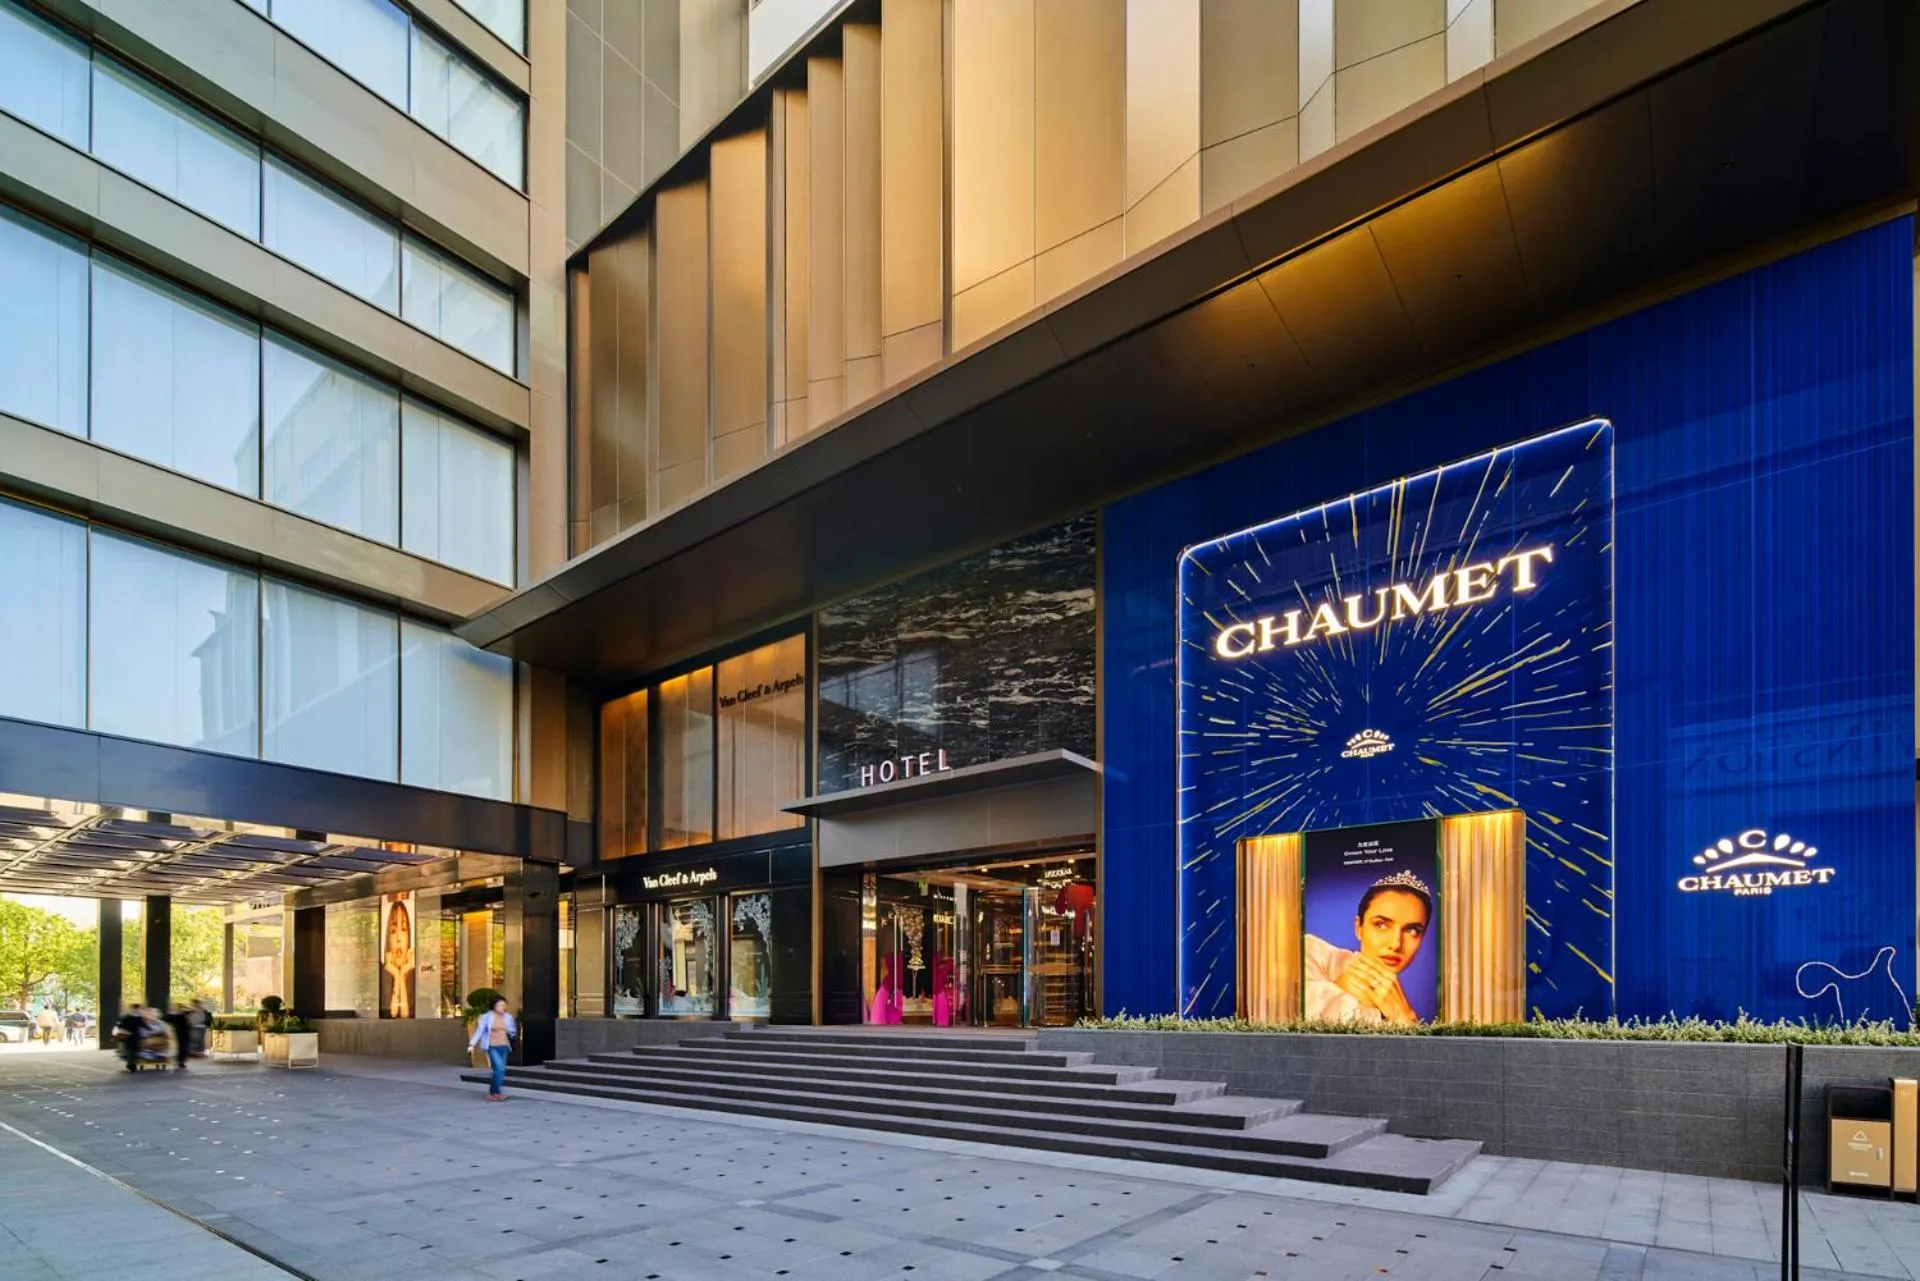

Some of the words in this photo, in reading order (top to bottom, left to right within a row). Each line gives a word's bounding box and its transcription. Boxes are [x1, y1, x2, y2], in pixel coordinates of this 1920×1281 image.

[1215, 544, 1555, 659] CHAUMET
[719, 695, 736, 708] Van
[737, 683, 763, 703] Cleef
[1341, 743, 1395, 758] CHAUMET
[861, 748, 951, 787] HOTEL
[1738, 829, 1767, 849] C
[642, 876, 659, 889] Van
[659, 872, 682, 887] Cleef
[682, 873, 689, 884] &
[689, 867, 718, 886] Arpels
[1677, 867, 1836, 892] CHAUMET
[1733, 886, 1773, 897] PARIS
